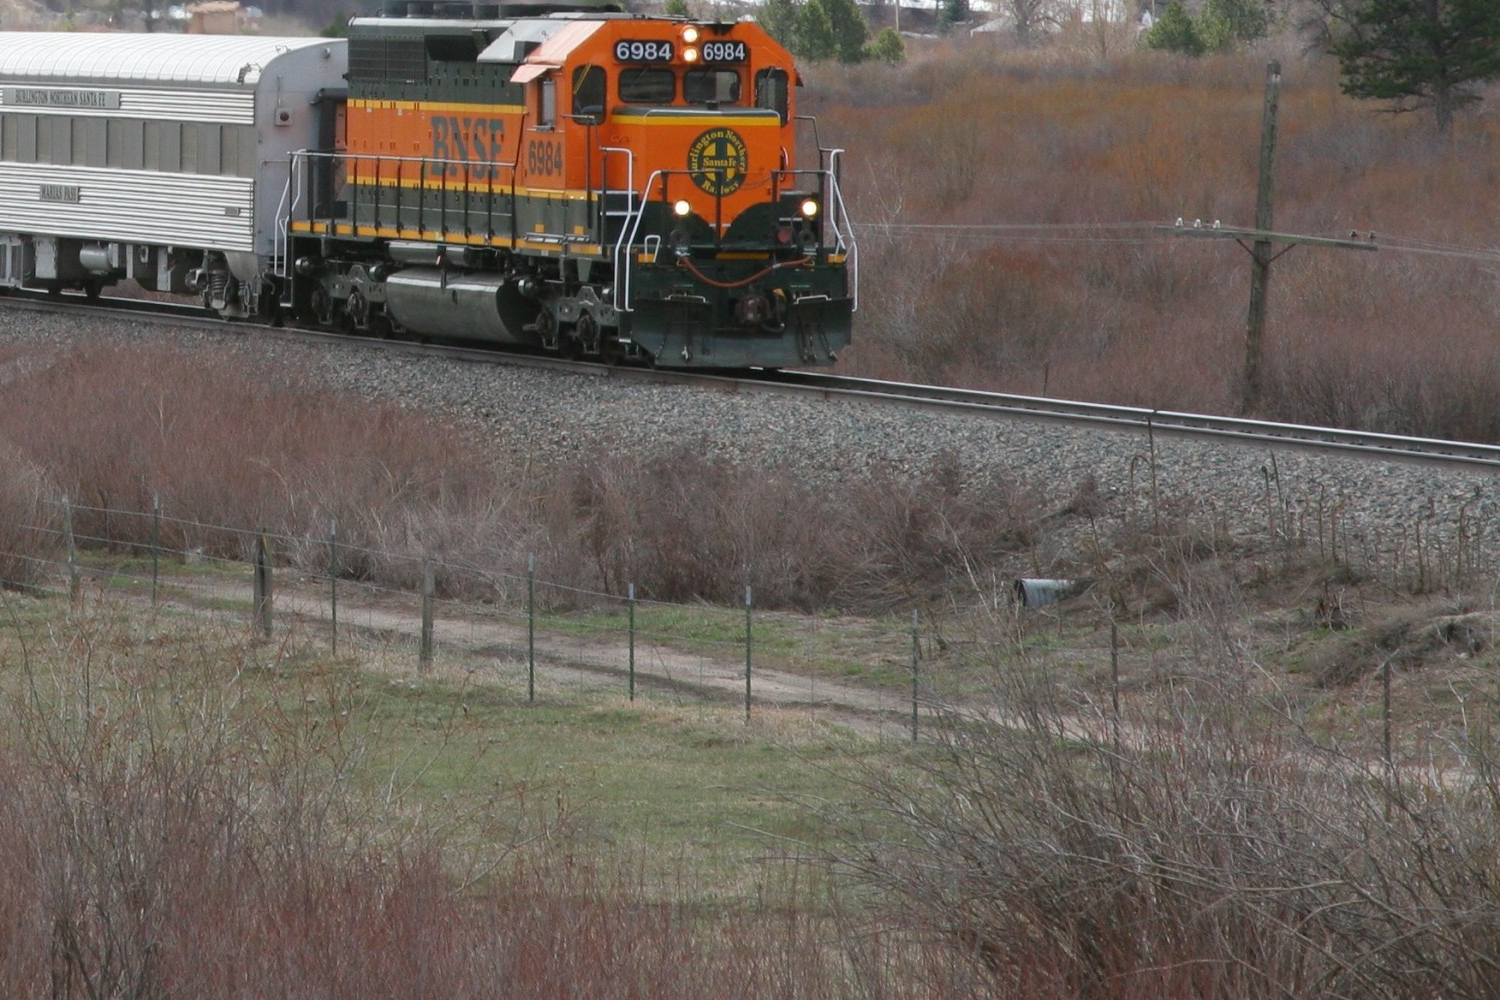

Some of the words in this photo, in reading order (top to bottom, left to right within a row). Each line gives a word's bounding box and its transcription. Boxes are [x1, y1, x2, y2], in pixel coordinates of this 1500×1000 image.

[616, 42, 672, 60] 6984
[703, 43, 746, 60] 6984
[15, 88, 48, 104] BURLINGTON
[49, 90, 78, 105] NORTHERN
[79, 91, 97, 106] SANTA
[98, 92, 106, 107] FE
[431, 116, 505, 179] BNSF
[528, 140, 563, 176] 6984
[703, 157, 728, 167] Santa
[728, 158, 737, 167] Fe
[702, 180, 739, 195] Ralway
